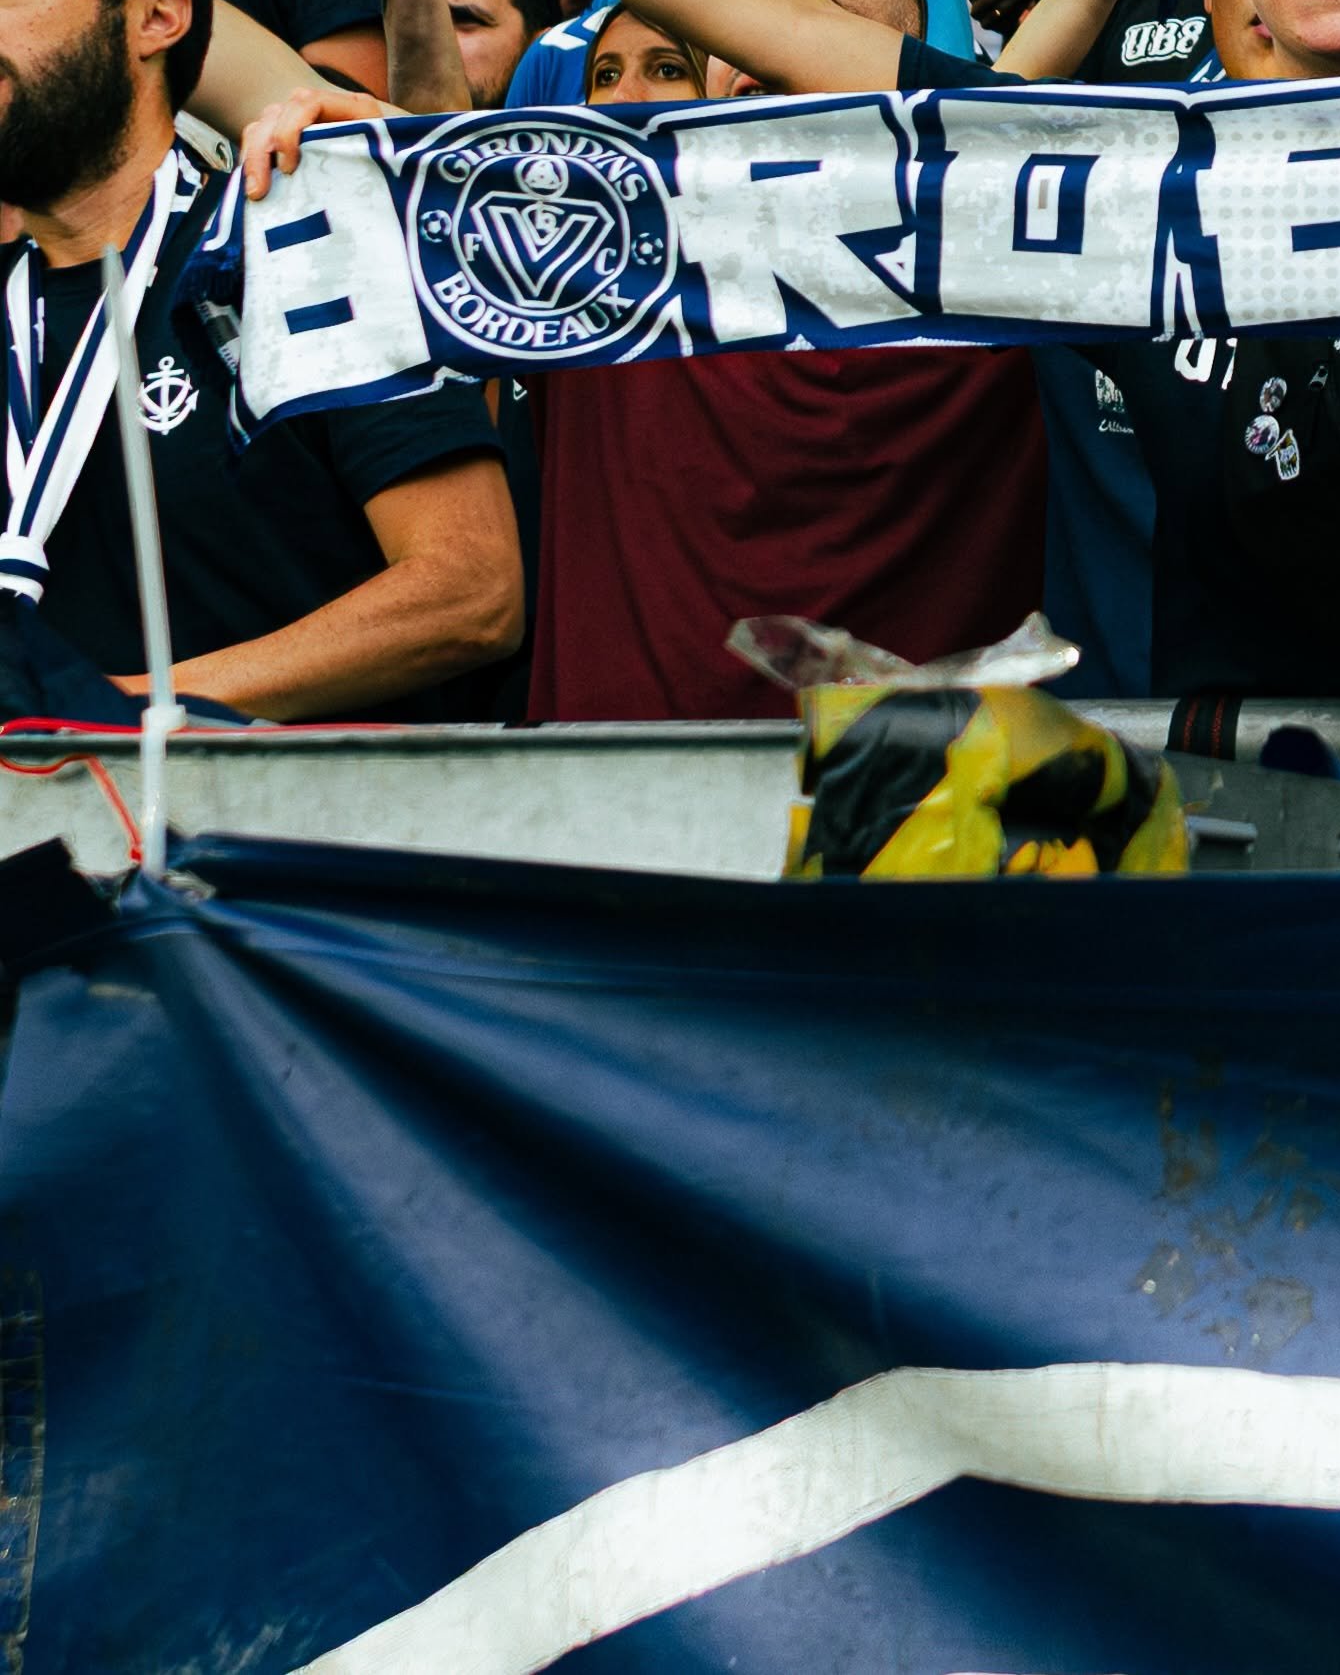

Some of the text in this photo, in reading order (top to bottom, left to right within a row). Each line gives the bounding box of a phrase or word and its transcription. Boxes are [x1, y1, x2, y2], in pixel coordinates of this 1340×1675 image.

[1121, 20, 1206, 65] UB8
[436, 131, 649, 203] GIRONDINS
[463, 232, 617, 276] F C
[432, 270, 636, 348] BORDEAUX
